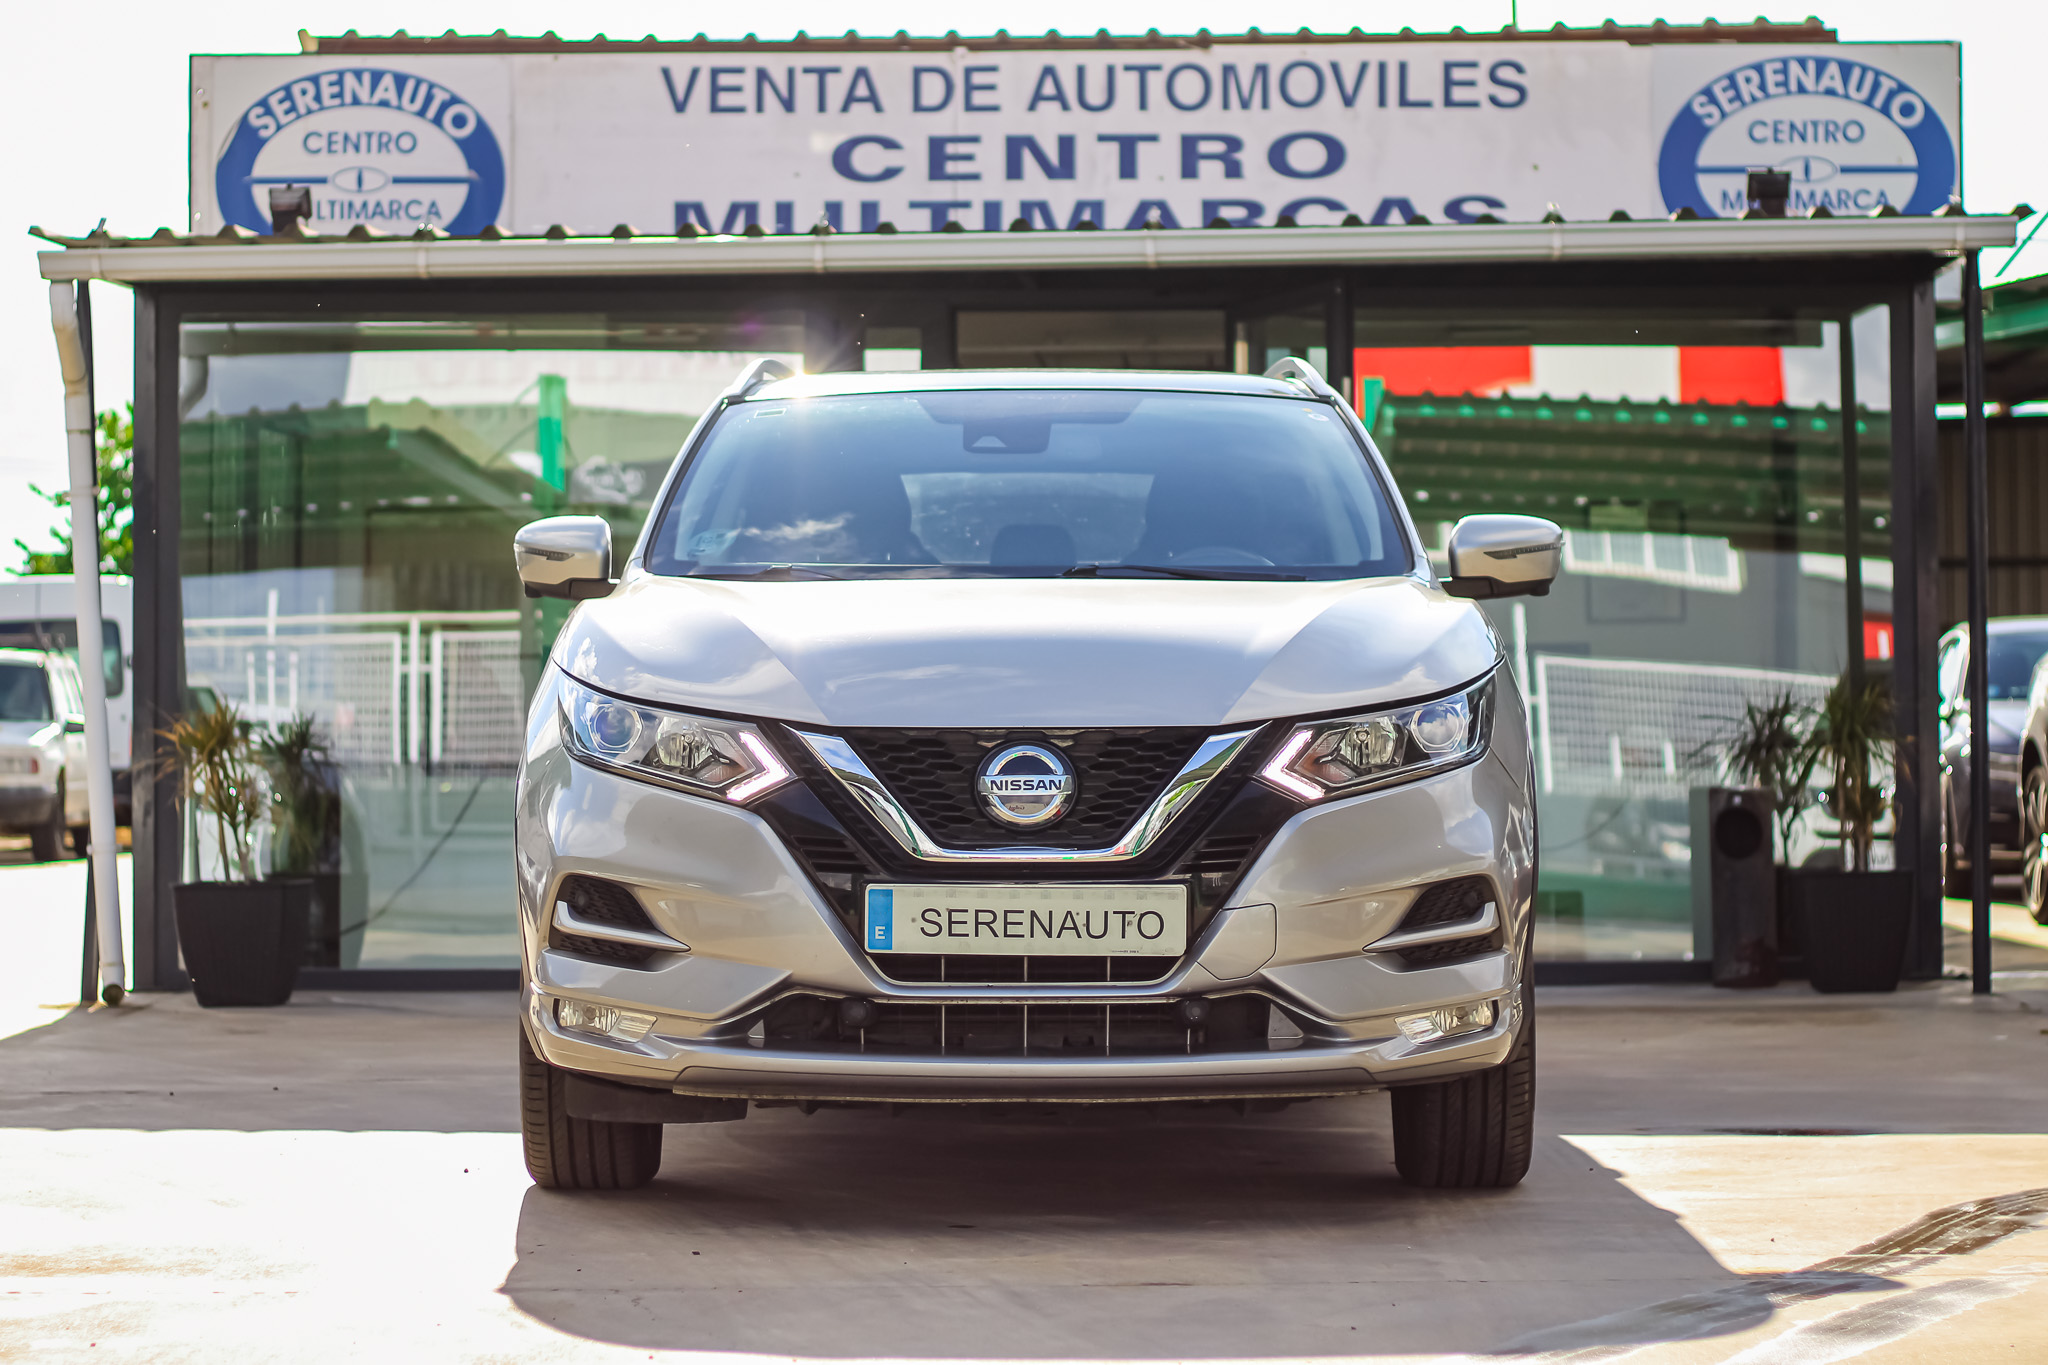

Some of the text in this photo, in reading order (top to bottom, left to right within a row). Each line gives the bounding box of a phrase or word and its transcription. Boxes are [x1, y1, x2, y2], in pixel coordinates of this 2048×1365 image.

[660, 58, 1528, 114] VENTA DE AUTOMOVILES
[1691, 59, 1926, 128] SERENAUTO
[247, 70, 479, 139] SERENAUTO
[302, 131, 418, 155] CENTRO
[1747, 119, 1866, 145] CENTRO
[831, 130, 1347, 182] CENTRO
[314, 198, 443, 222] LTIMARCA
[1721, 187, 1891, 211] MMARCA
[989, 778, 1063, 792] NISSAN
[874, 926, 886, 940] E
[919, 907, 1166, 940] SERENAUTO
